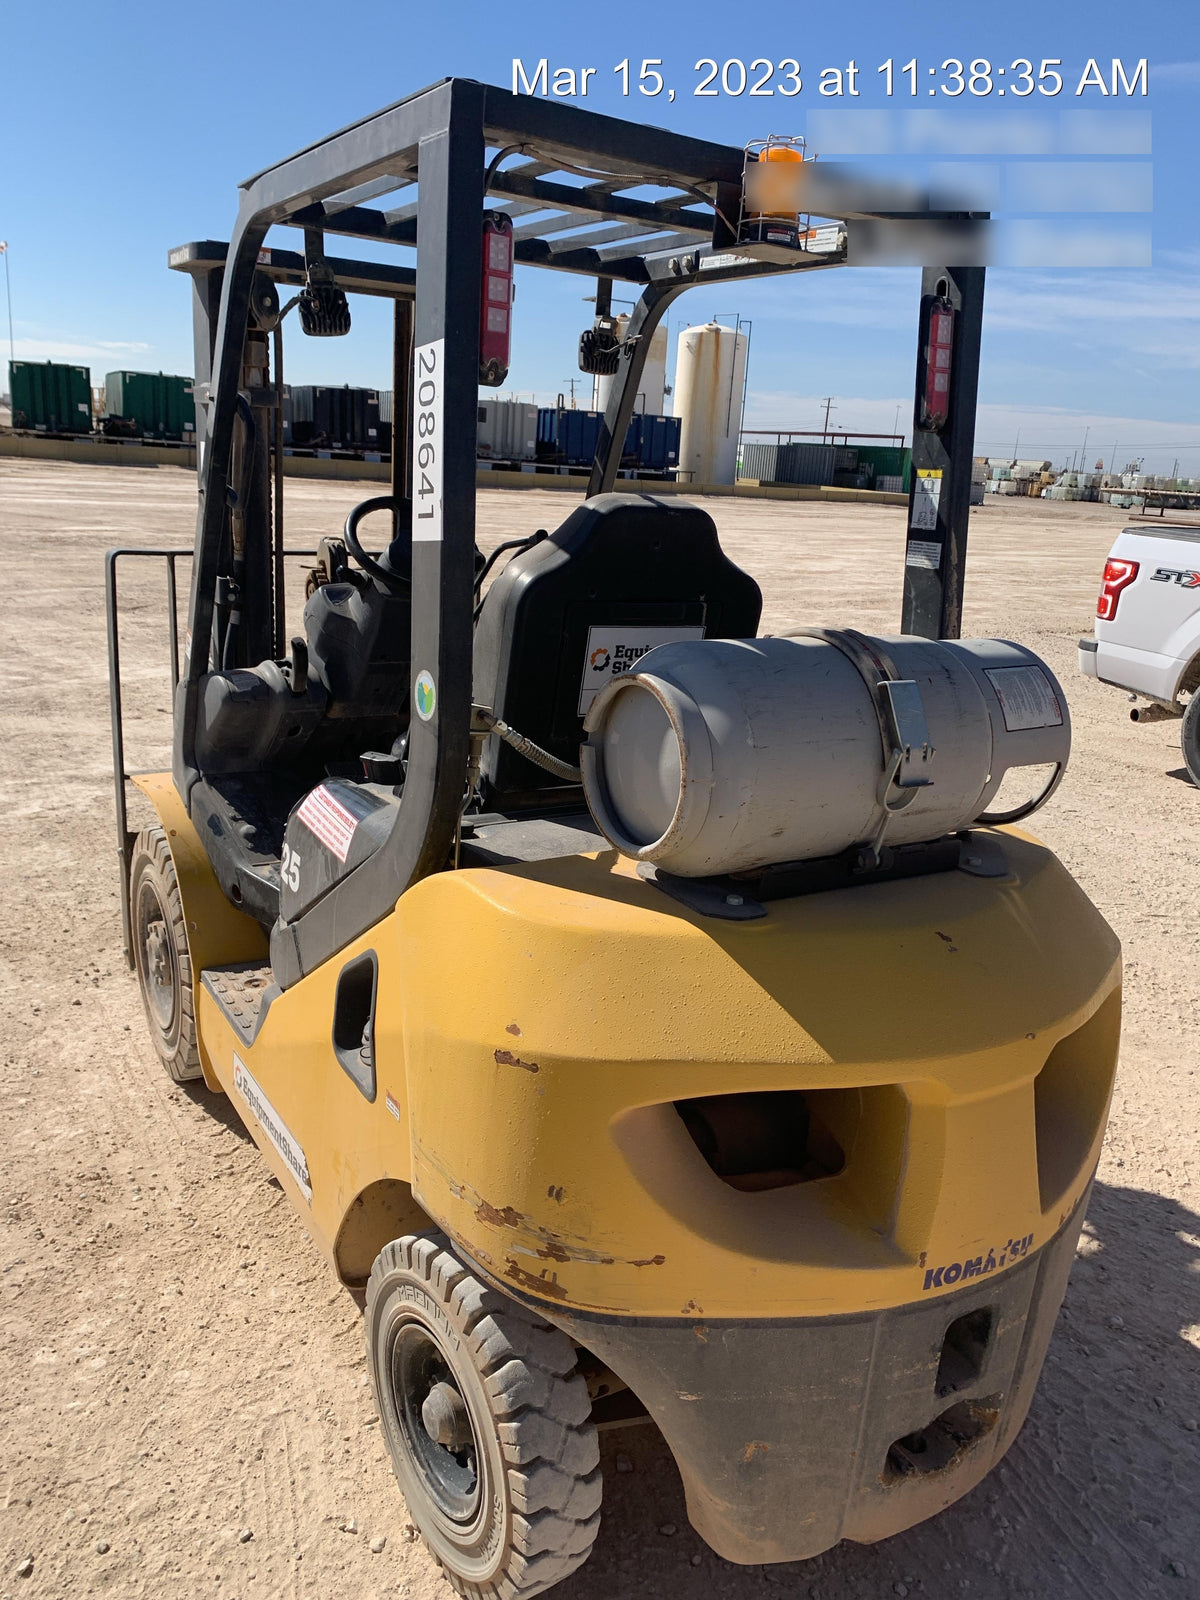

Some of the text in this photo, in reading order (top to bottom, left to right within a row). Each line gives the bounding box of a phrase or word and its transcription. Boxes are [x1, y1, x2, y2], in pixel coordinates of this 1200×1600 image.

[418, 348, 437, 519] 208641
[1150, 567, 1200, 588] STX
[281, 843, 301, 892] 25
[242, 1076, 308, 1183] EquipmentShare
